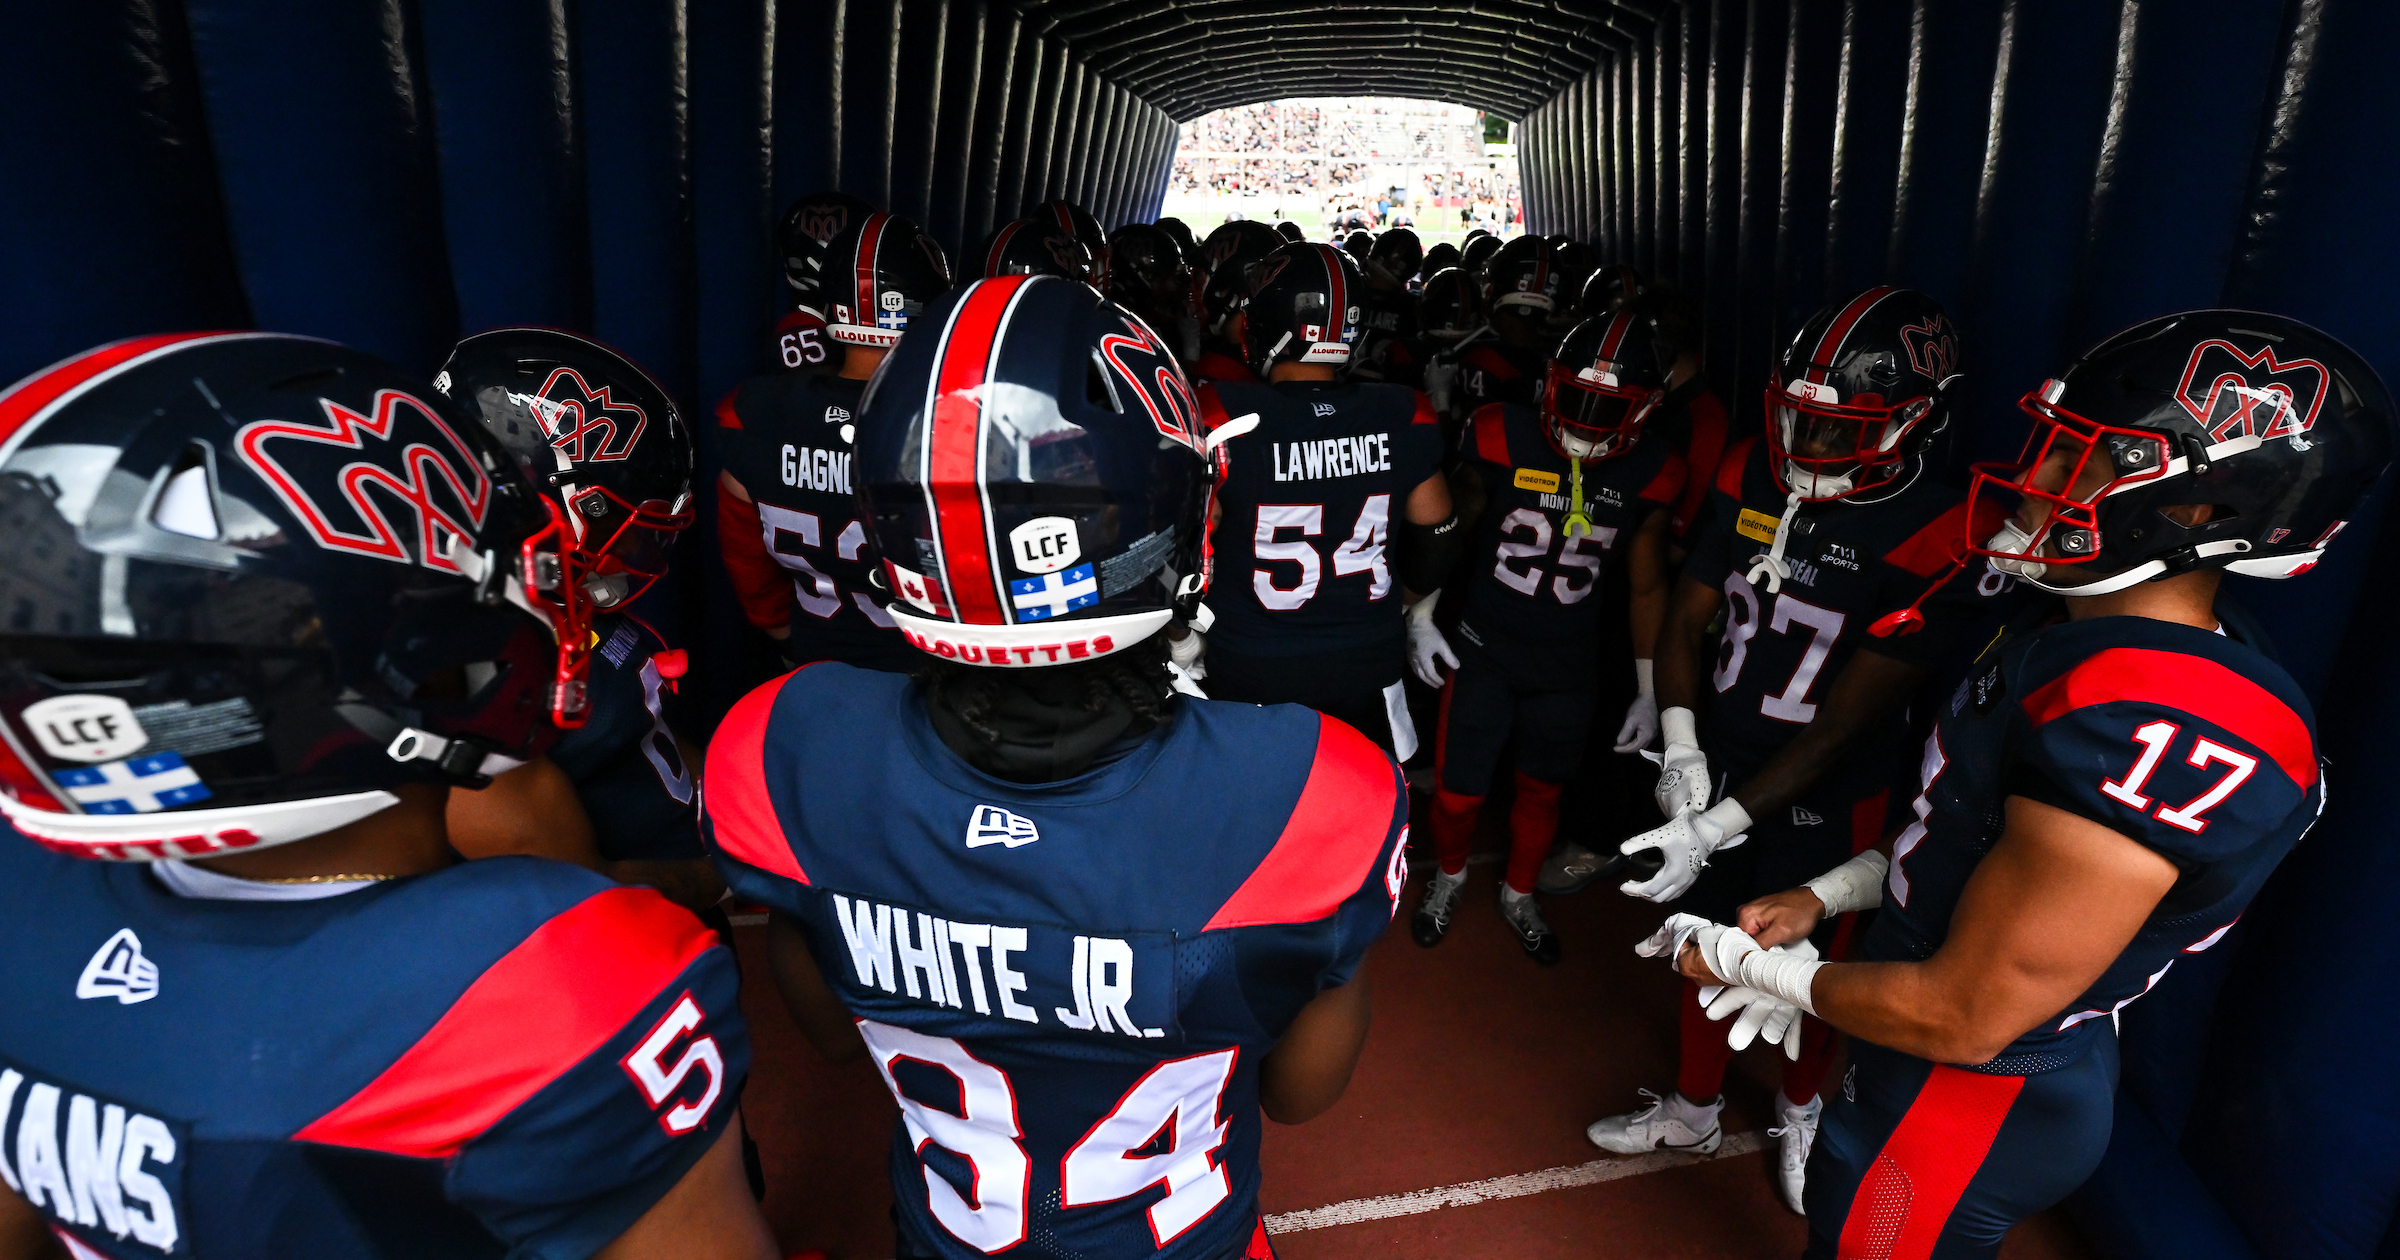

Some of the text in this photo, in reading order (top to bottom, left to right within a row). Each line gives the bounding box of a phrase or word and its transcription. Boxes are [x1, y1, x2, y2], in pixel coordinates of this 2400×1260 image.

[780, 327, 827, 369] 65
[834, 330, 898, 345] ALOUETT
[781, 443, 854, 495] GAGNO
[1273, 432, 1392, 482] LAWRENCE
[1594, 494, 1624, 508] SPORTS
[1023, 532, 1068, 561] LCF
[1252, 492, 1393, 611] 54
[1493, 507, 1619, 605] 25
[1820, 553, 1860, 571] SPORTS
[902, 628, 1115, 665] ALOUETTES
[1712, 569, 1847, 725] 87
[47, 713, 121, 747] LCF
[2098, 719, 2260, 836] 17
[833, 893, 1166, 1039] WHITE JR.
[617, 988, 726, 1136] 5
[854, 1017, 1241, 1254] 84
